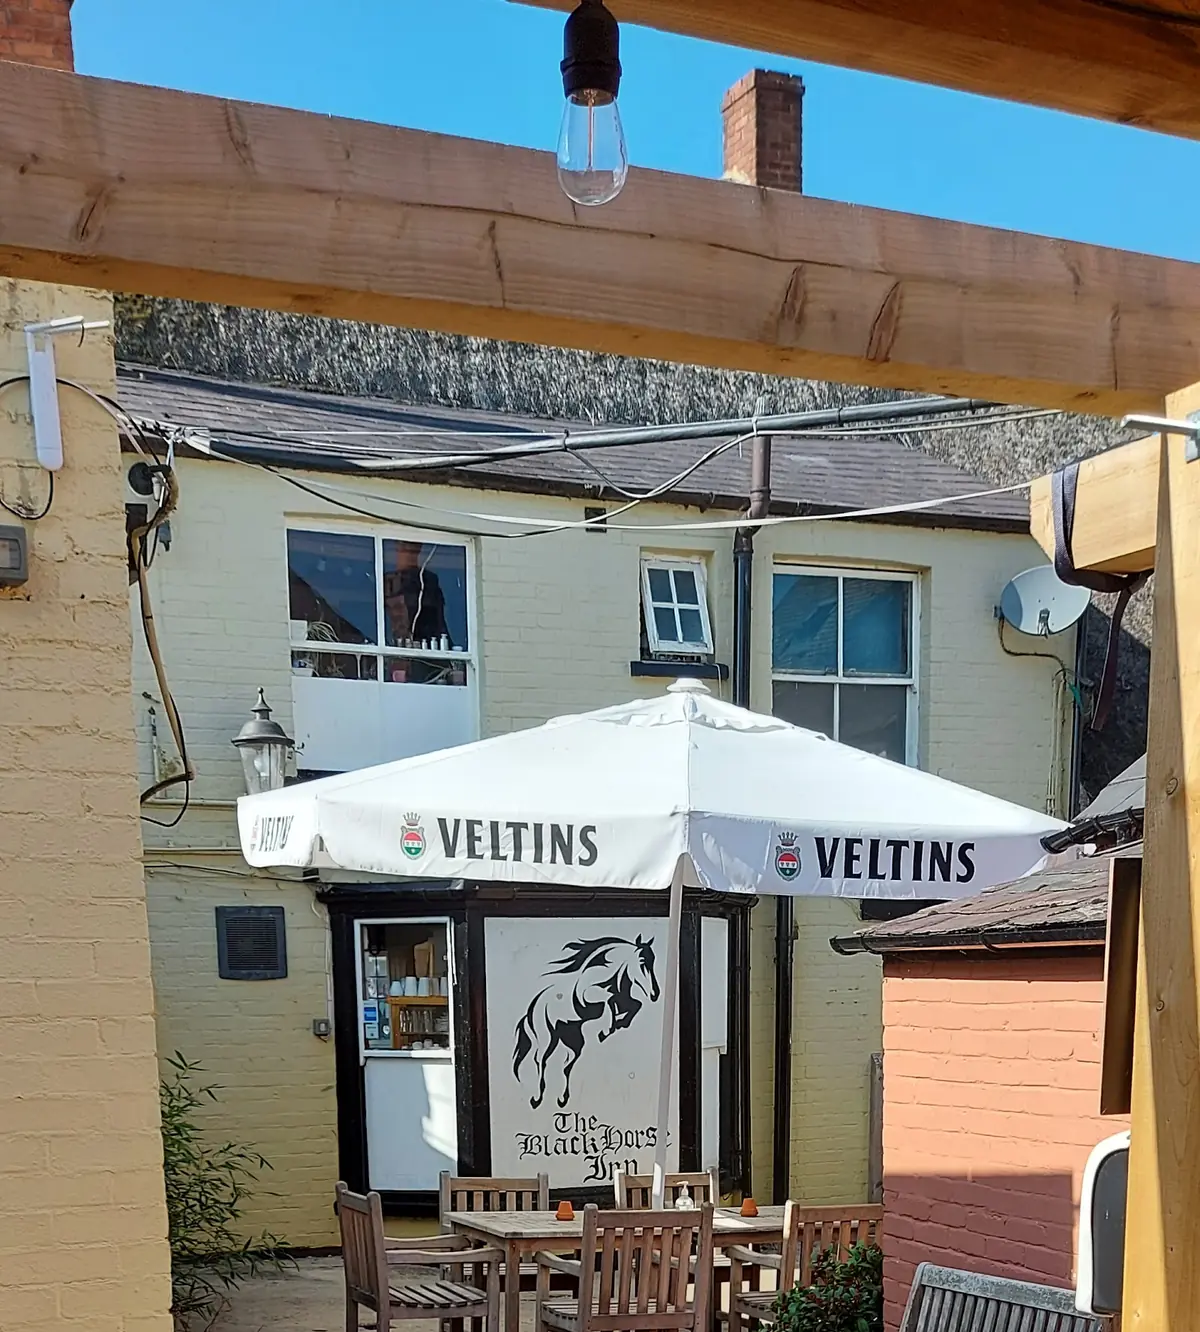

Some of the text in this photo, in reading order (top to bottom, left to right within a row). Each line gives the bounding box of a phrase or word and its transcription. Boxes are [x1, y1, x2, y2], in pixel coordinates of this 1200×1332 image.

[437, 817, 597, 867] VELTINS
[814, 836, 975, 883] VELTINS
[553, 1112, 598, 1133] The
[515, 1133, 599, 1160] Black
[583, 1153, 638, 1183] Inn
